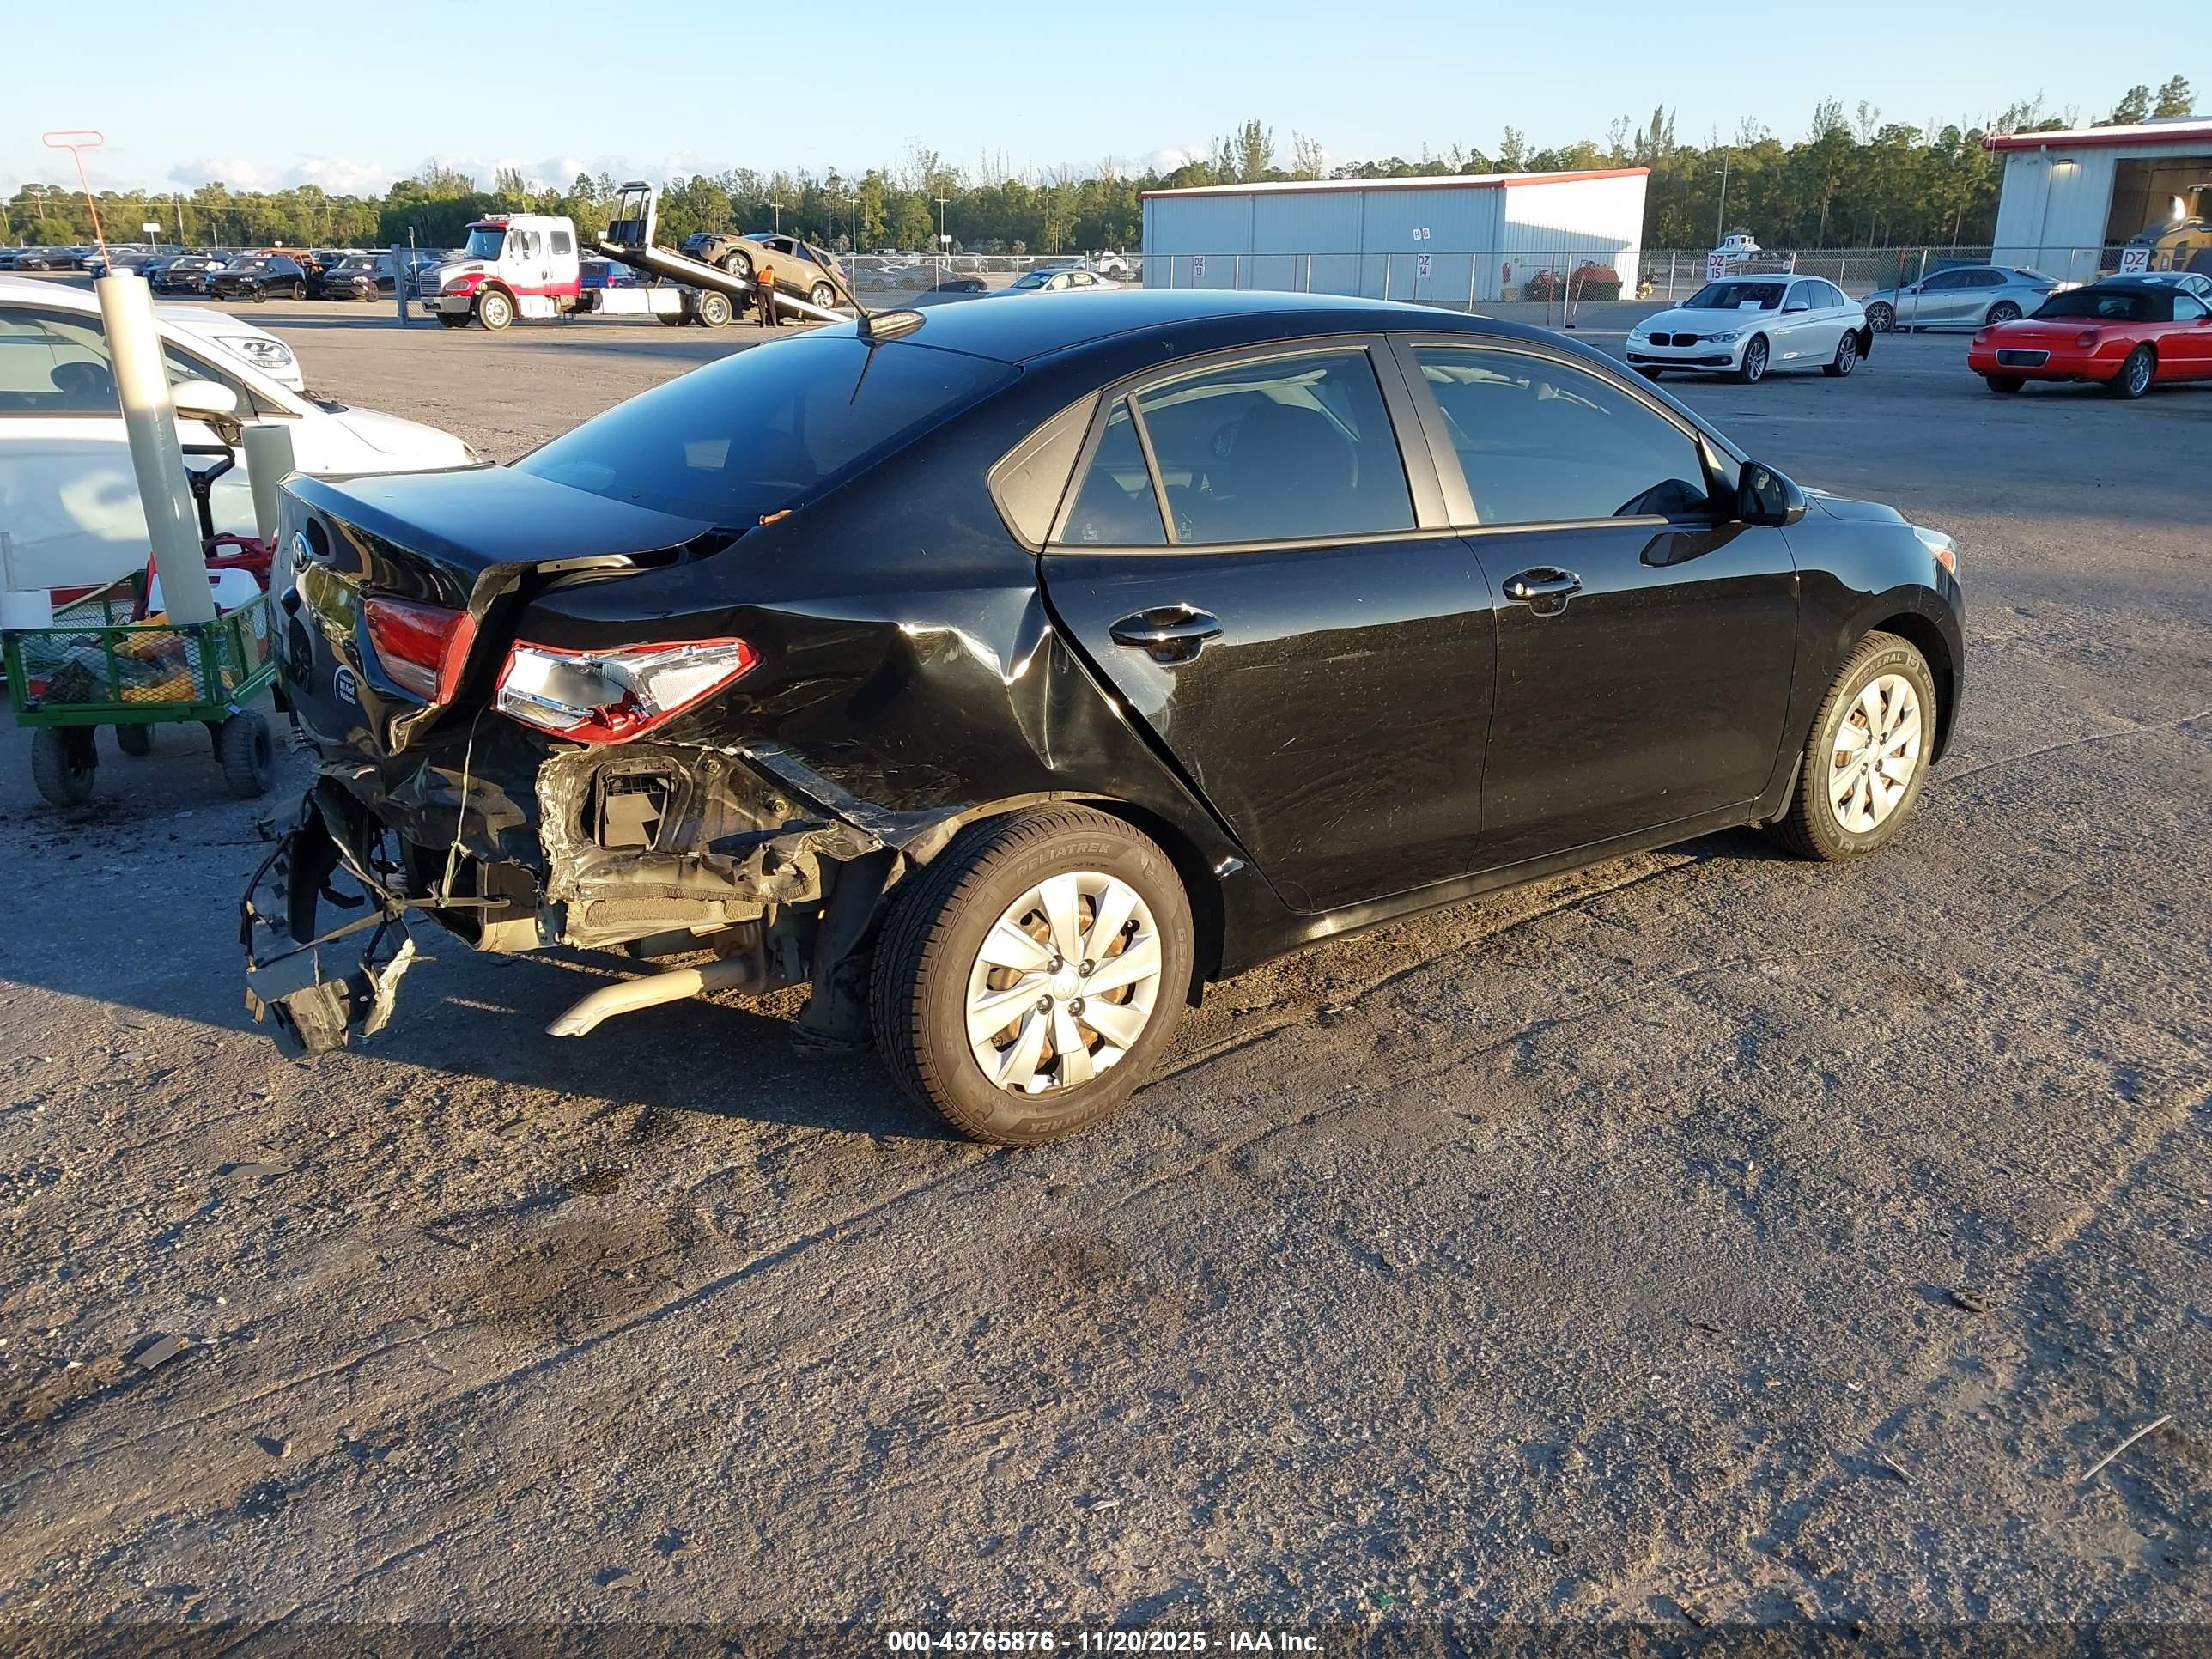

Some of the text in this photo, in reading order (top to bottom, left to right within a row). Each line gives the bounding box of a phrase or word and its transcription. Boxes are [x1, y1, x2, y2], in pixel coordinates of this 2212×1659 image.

[1194, 258, 1203, 266] DZ
[1418, 255, 1430, 265] DZ
[1709, 255, 1724, 266] DZ
[2124, 252, 2147, 265] DZ
[1419, 266, 1427, 276] 14
[1711, 267, 1721, 279] 15
[1856, 653, 1902, 687] GENERAL
[1016, 842, 1112, 879] RELIATREK
